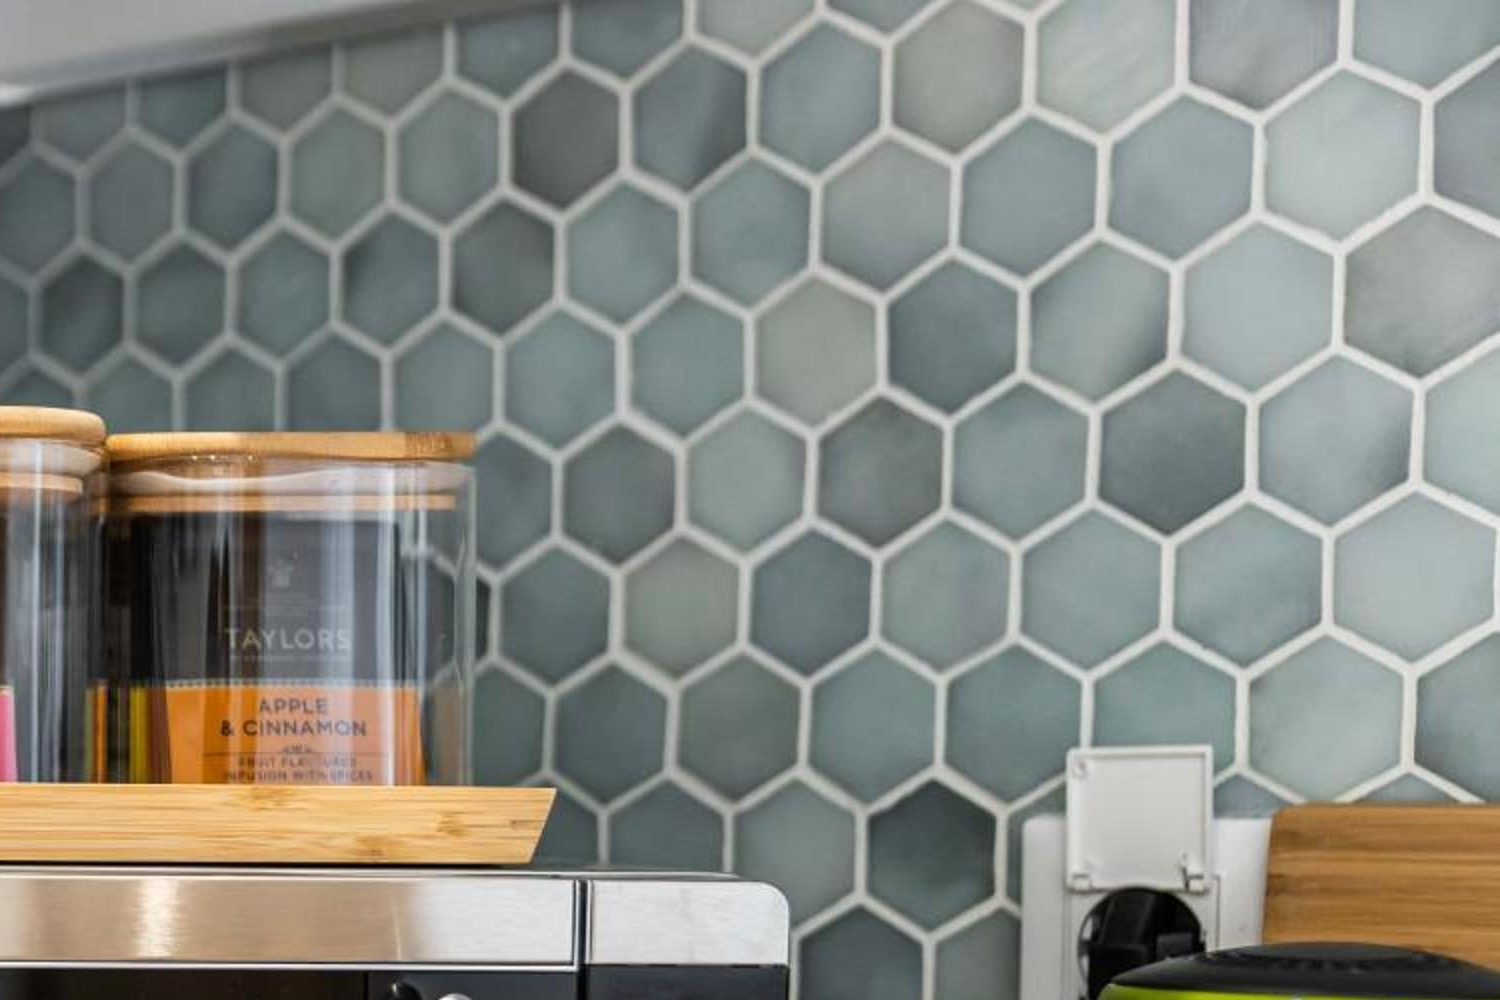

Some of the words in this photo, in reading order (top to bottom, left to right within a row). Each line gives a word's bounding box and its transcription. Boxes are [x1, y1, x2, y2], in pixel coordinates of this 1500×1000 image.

[225, 627, 350, 650] TAYLORS
[259, 698, 329, 714] APPLE
[220, 720, 234, 736] &
[243, 719, 366, 736] CINNAMON
